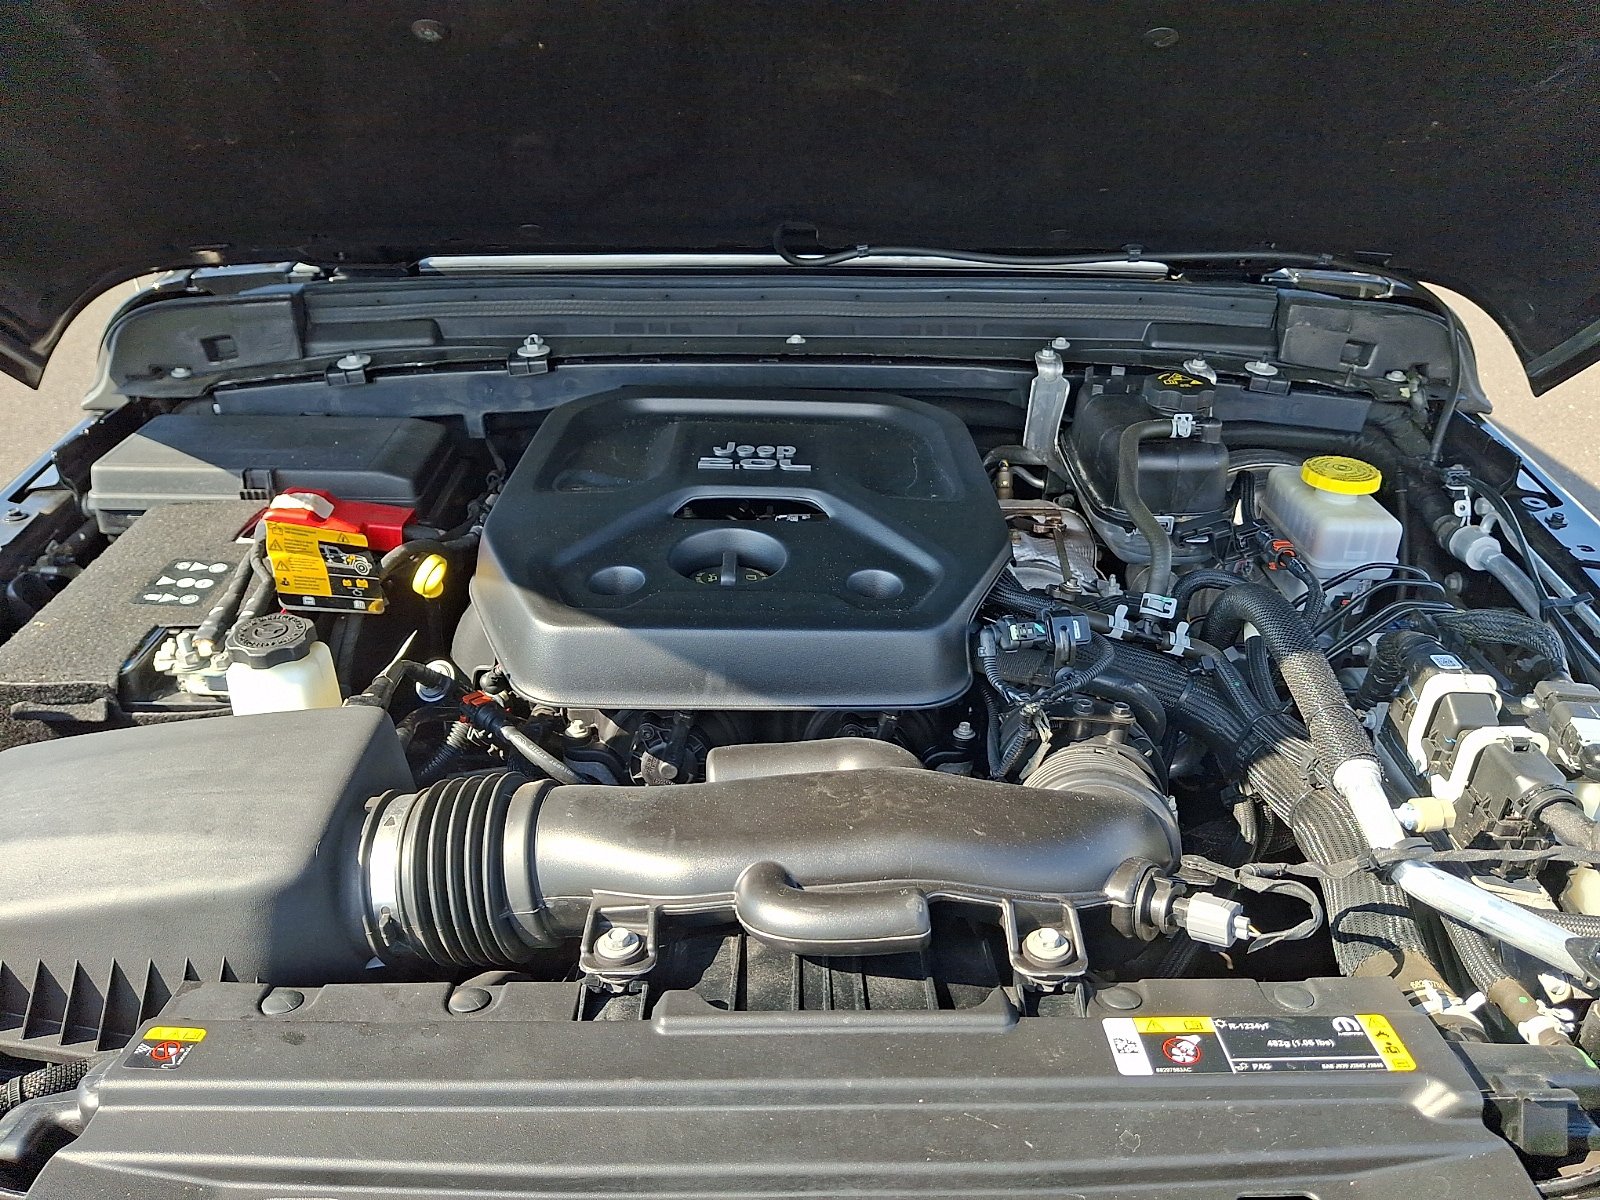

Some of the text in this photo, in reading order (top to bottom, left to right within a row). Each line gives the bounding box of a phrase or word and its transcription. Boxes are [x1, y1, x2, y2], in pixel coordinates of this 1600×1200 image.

[712, 441, 797, 459] Jeep
[697, 457, 812, 472] 2.0L
[1228, 1021, 1270, 1031] R-1234yf
